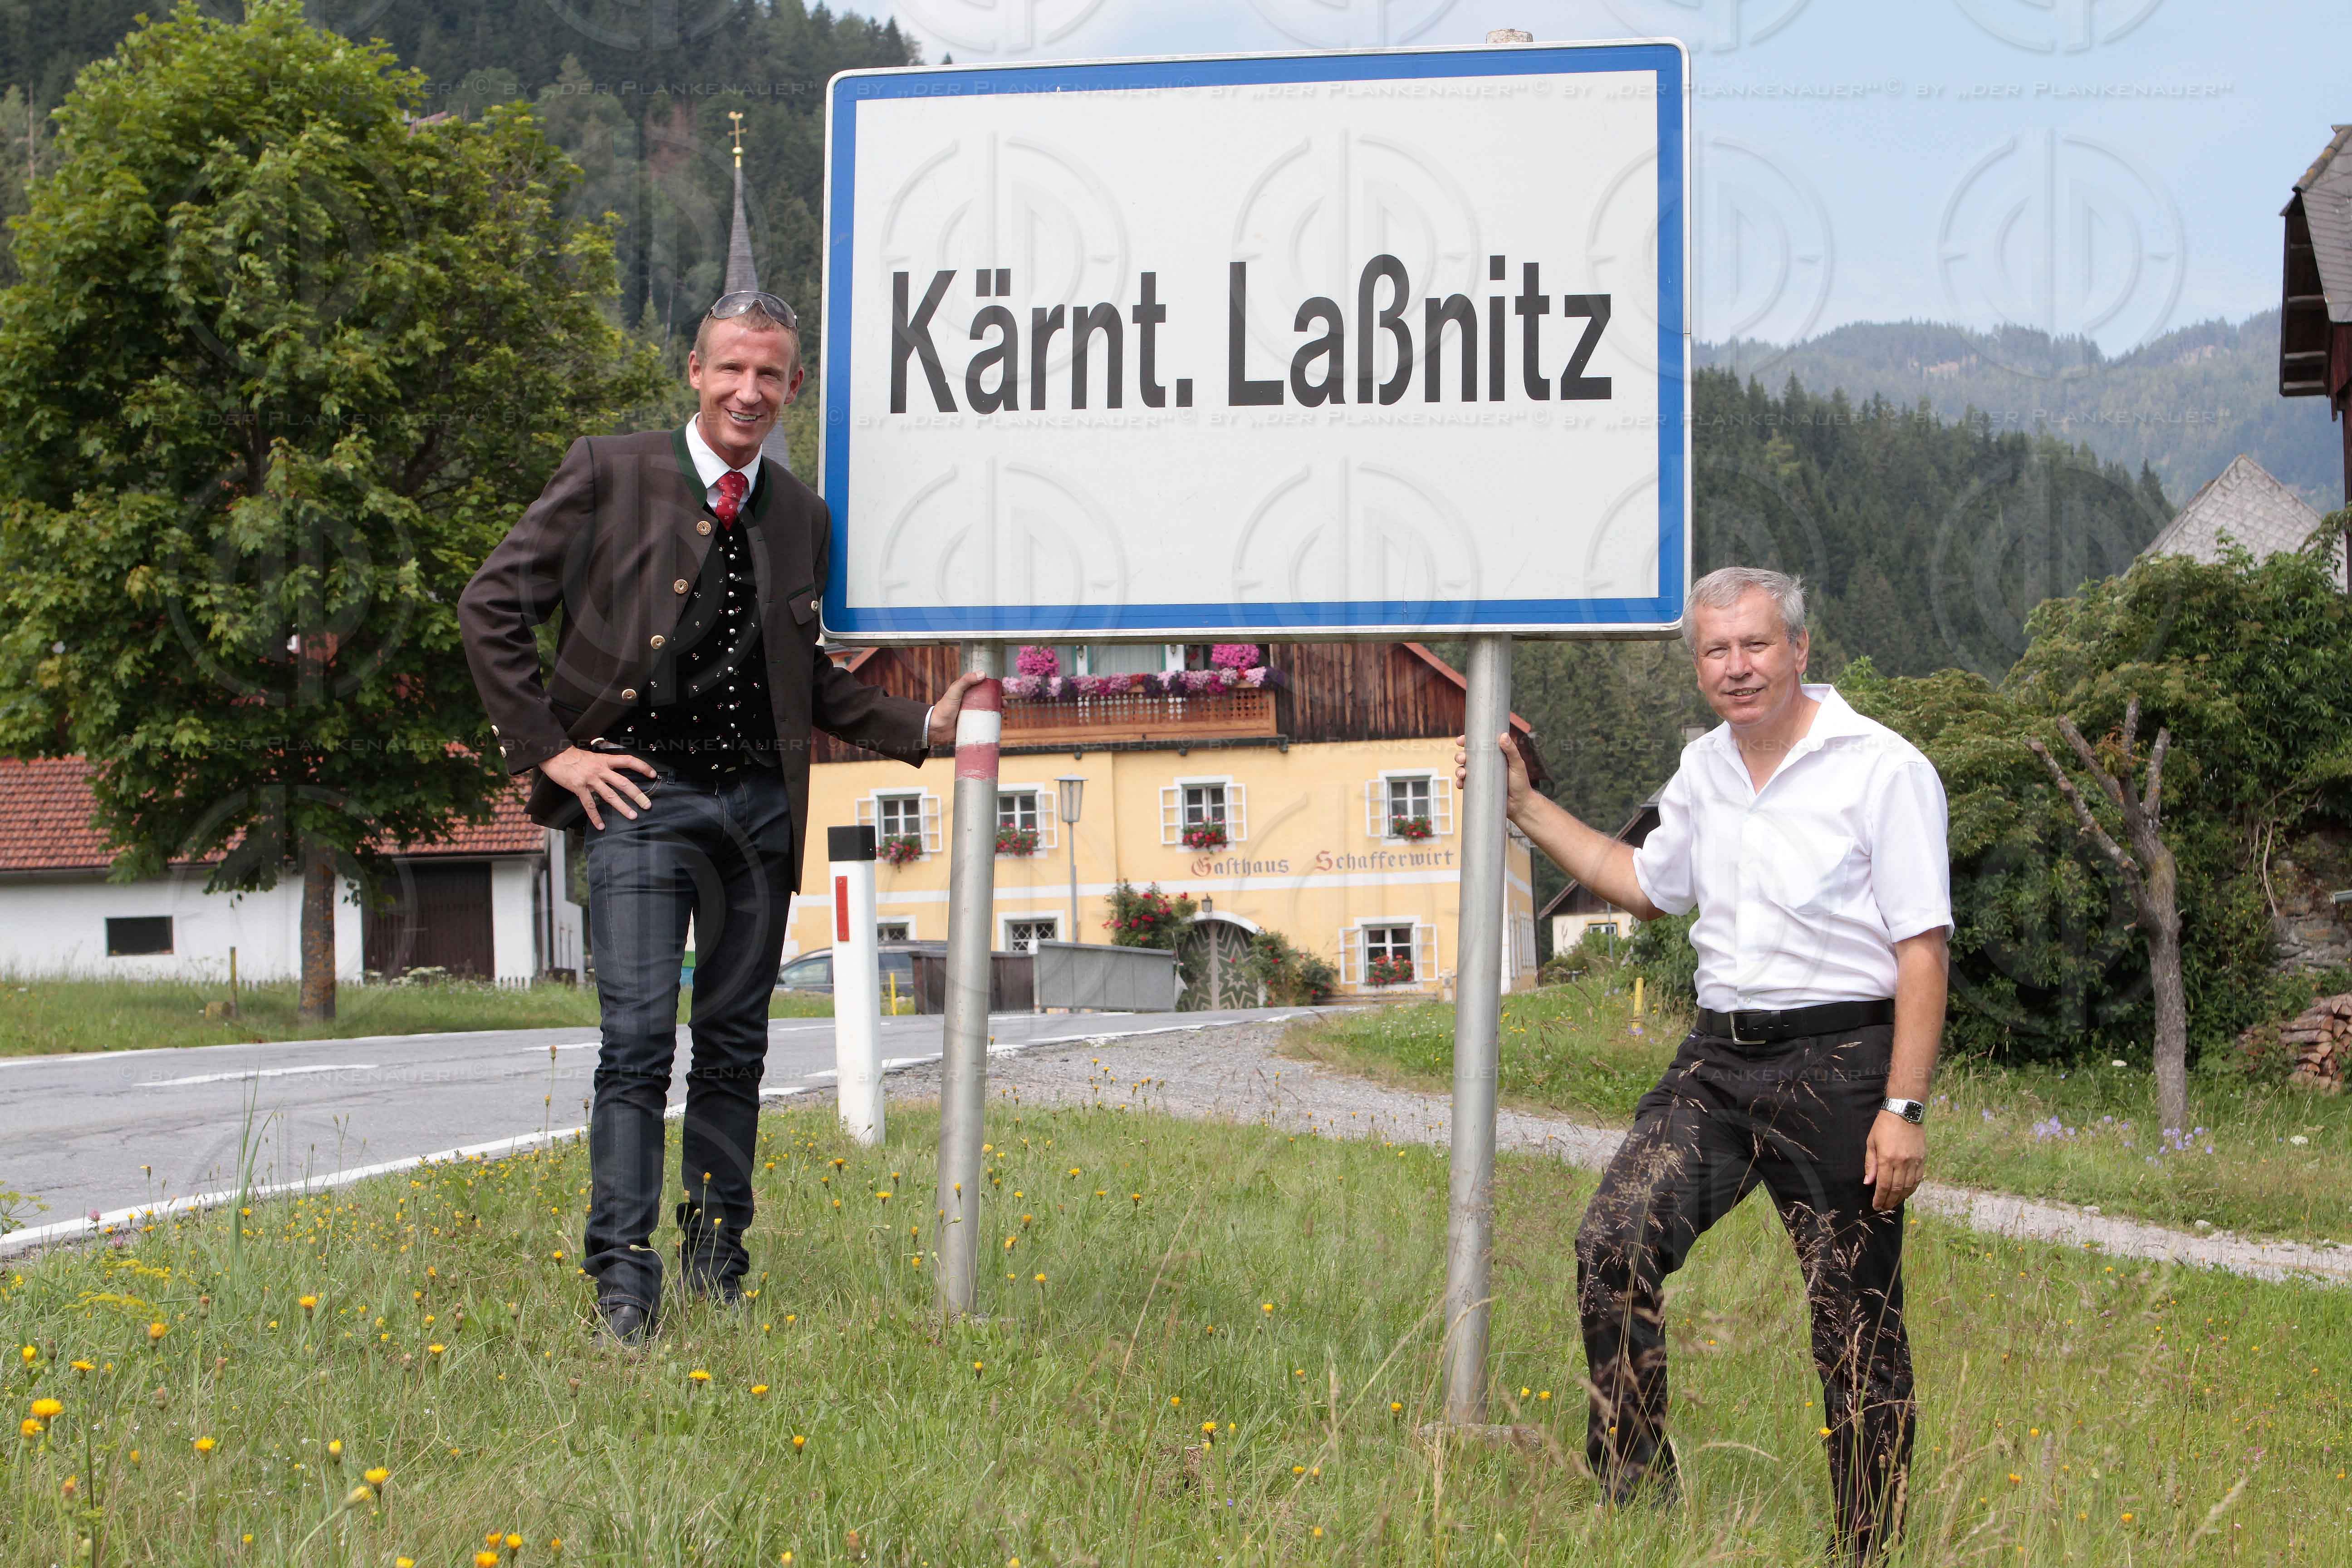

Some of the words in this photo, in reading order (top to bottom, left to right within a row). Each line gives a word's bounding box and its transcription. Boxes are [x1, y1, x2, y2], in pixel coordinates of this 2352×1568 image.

[890, 269, 1193, 414] Kärnt.
[1228, 254, 1612, 407] Laßnitz
[1315, 848, 1454, 871] Schafferwirt
